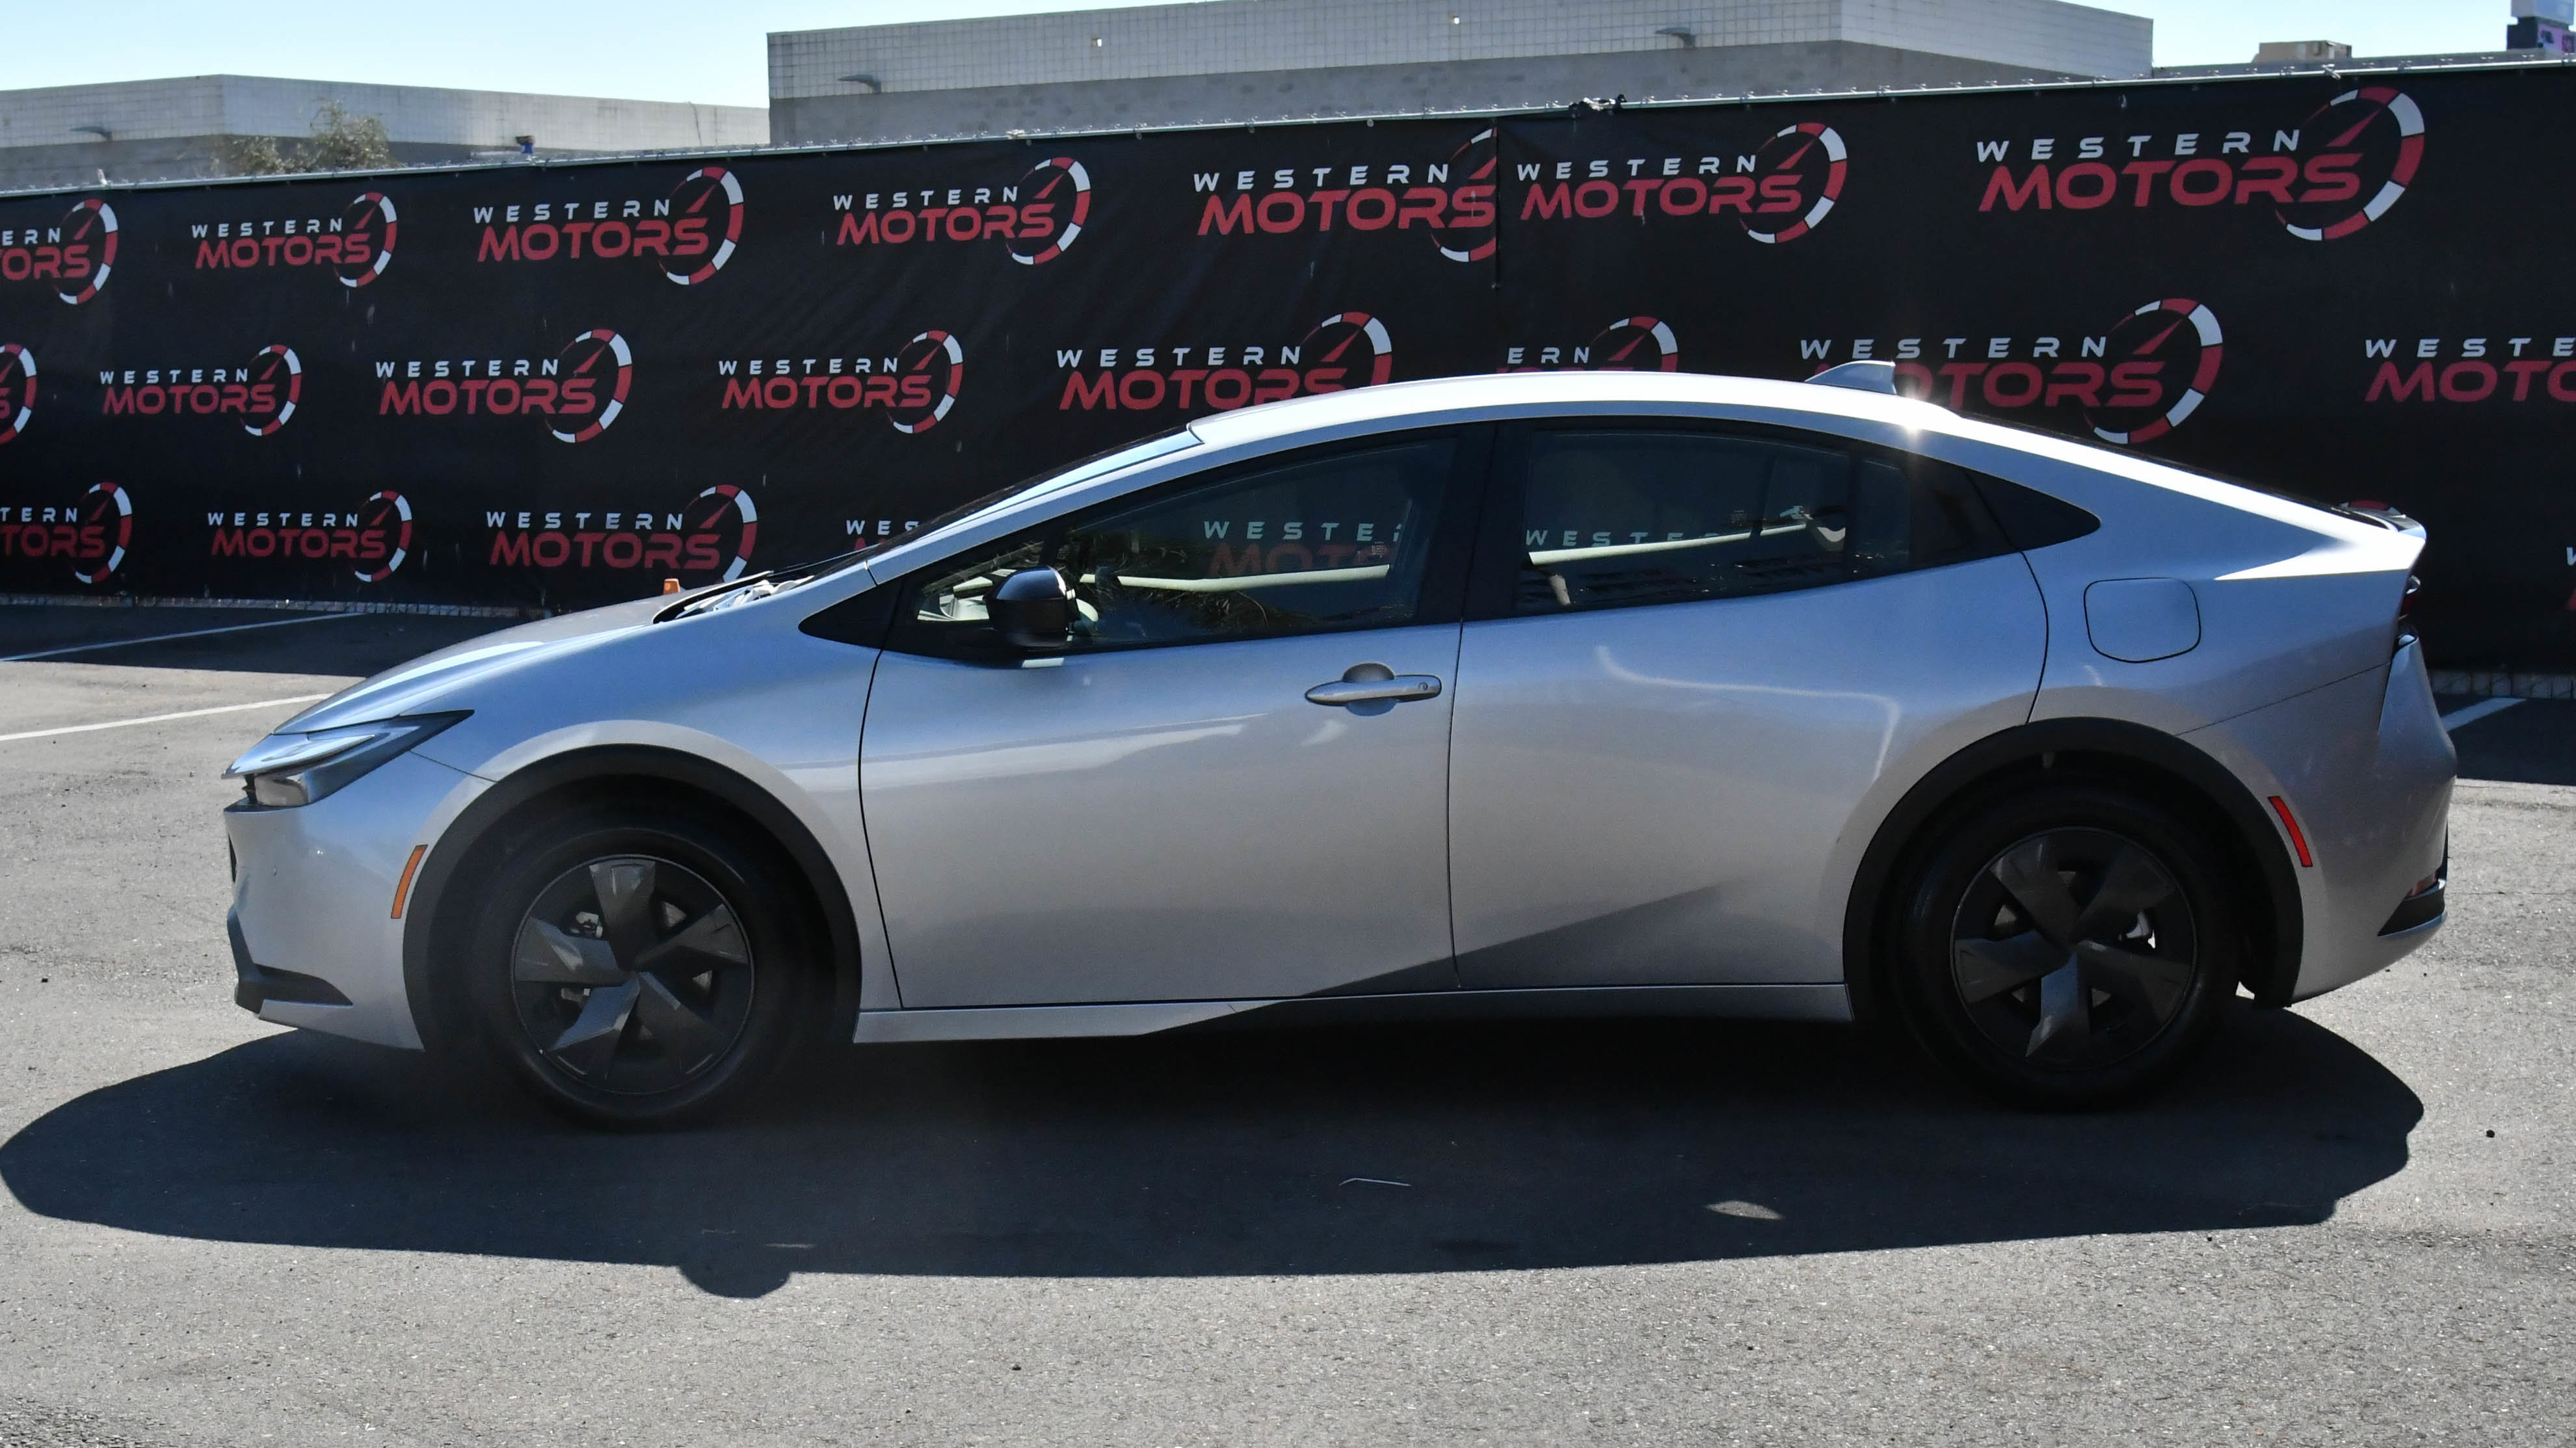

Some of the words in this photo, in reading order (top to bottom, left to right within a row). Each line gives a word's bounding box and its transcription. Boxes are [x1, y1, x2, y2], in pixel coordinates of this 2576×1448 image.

[1976, 129, 2300, 163] WESTERN
[1193, 163, 1448, 192] WESTERN
[1517, 155, 1756, 181] WESTERN
[1978, 153, 2362, 212] MOTORS
[473, 199, 670, 224] WESTERN
[833, 186, 1018, 211] WESTERN
[1197, 184, 1496, 236] MOTORS
[1520, 174, 1803, 220] MOTORS
[191, 218, 342, 239] WESTERN
[837, 202, 1055, 245] MOTORS
[195, 232, 371, 269] MOTORS
[478, 217, 710, 261] MOTORS
[0, 244, 90, 280] ORS
[1056, 346, 1301, 368] WESTERN
[1507, 347, 1589, 364] ERN
[1800, 336, 2106, 359] WESTERN
[2365, 337, 2576, 358] WESTE
[100, 368, 248, 384] WESTERN
[375, 358, 559, 378] WESTERN
[719, 357, 898, 376] WESTERN
[103, 383, 276, 414] MOTORS
[379, 377, 596, 415] MOTORS
[723, 374, 932, 410] MOTORS
[1059, 367, 1348, 410] MOTORS
[1815, 361, 2165, 408] OTORS
[0, 507, 77, 522] TERN
[207, 512, 358, 527] WESTERN
[486, 511, 683, 530] WESTERN
[212, 528, 386, 559] MOTORS
[491, 530, 721, 570] MOTORS
